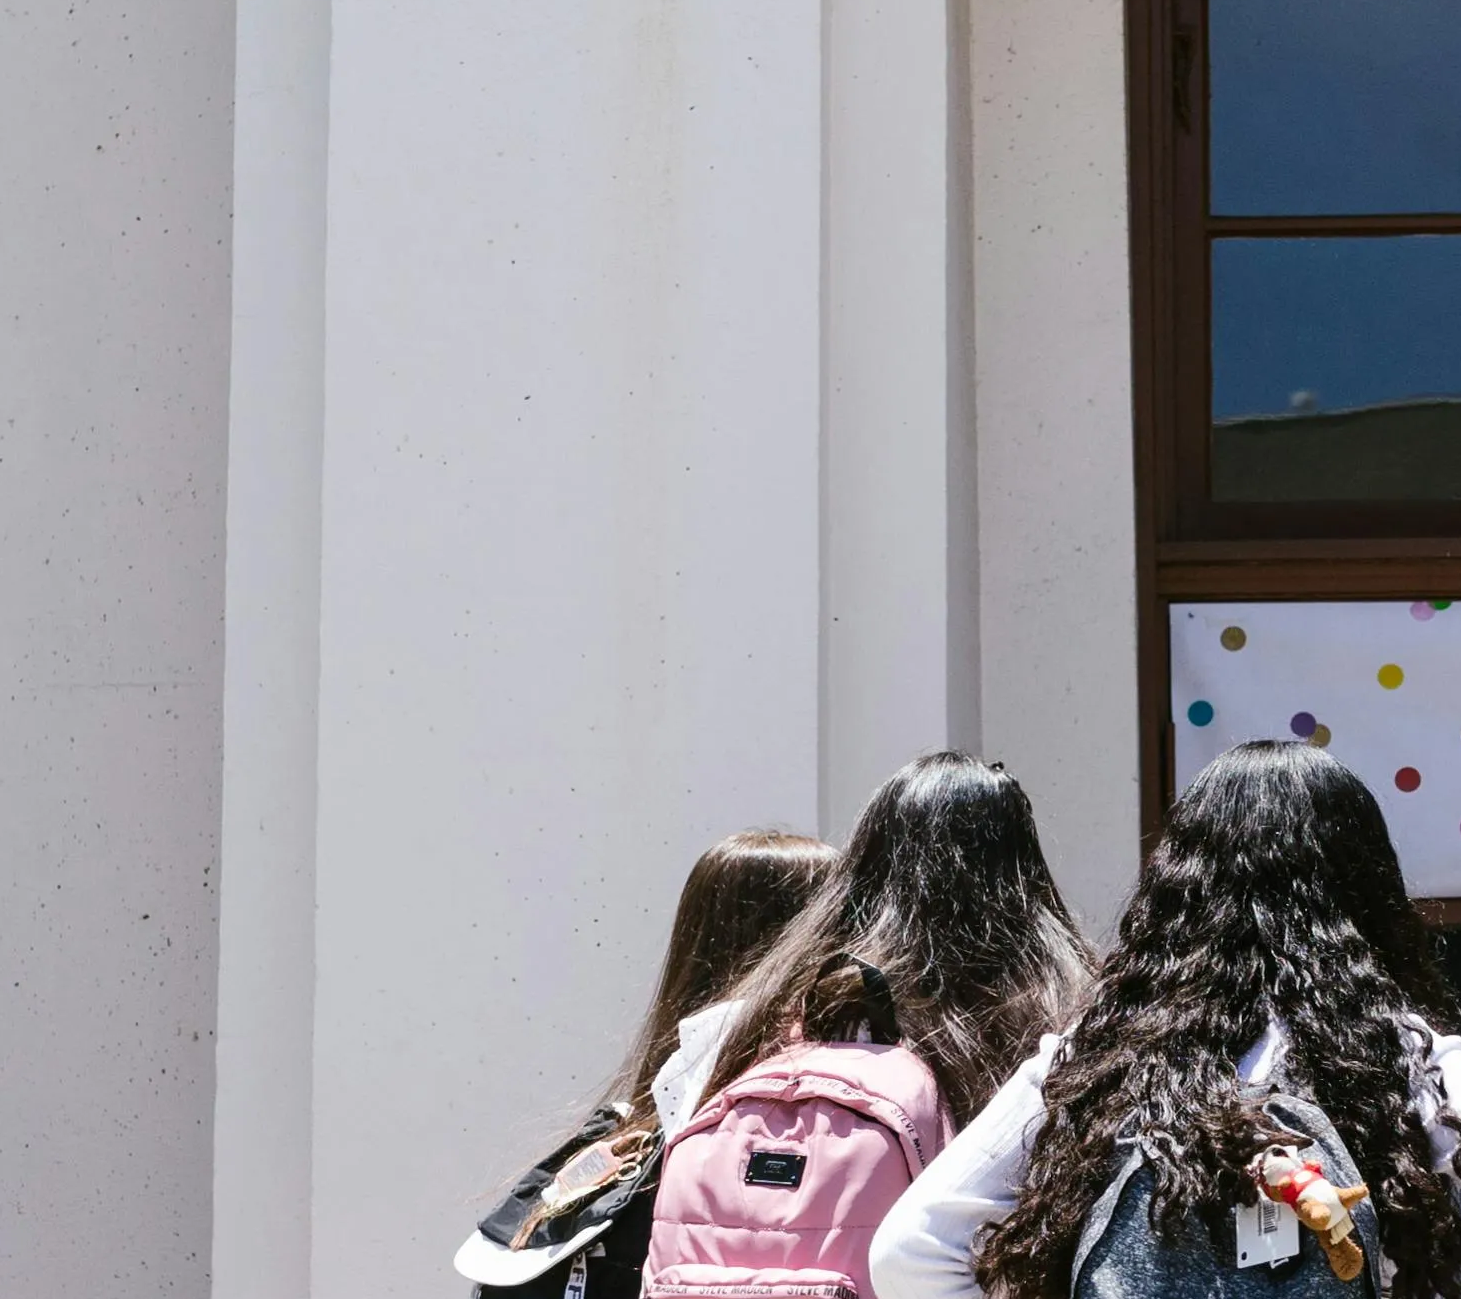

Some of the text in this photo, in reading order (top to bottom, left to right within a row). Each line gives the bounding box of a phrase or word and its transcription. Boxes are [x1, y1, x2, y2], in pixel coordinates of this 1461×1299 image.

[699, 1285, 728, 1296] STEVE
[731, 1286, 773, 1295] MADDEN
[787, 1286, 820, 1297] STEVE
